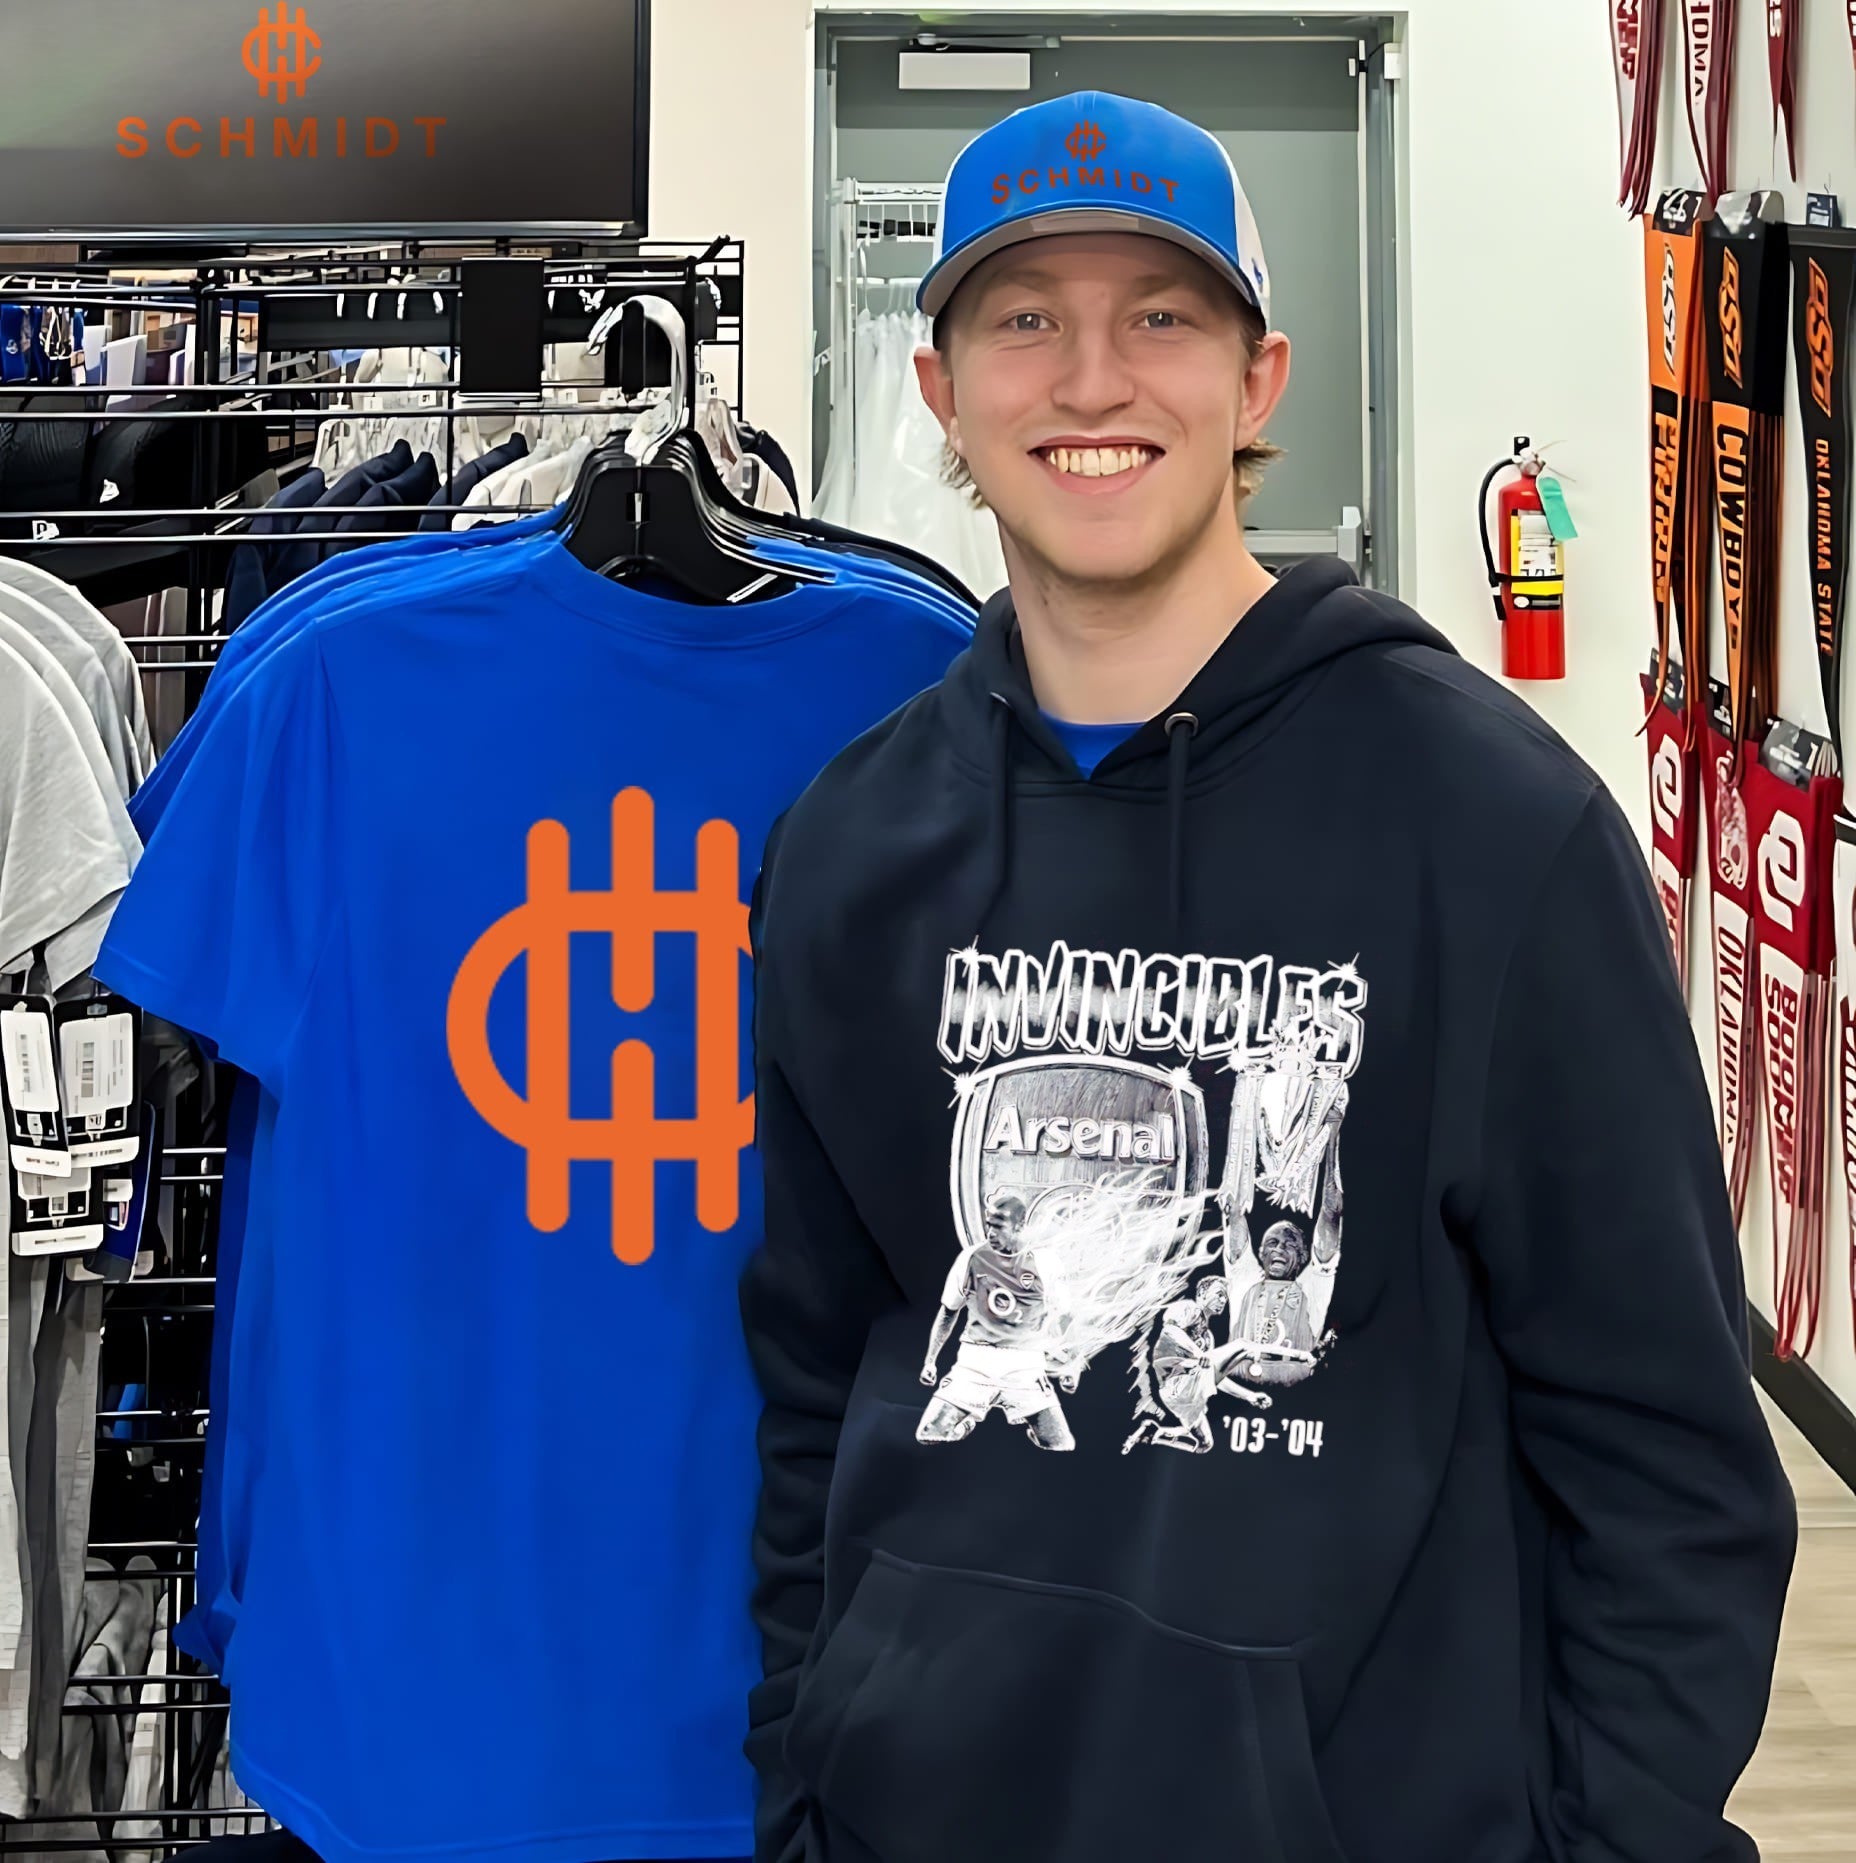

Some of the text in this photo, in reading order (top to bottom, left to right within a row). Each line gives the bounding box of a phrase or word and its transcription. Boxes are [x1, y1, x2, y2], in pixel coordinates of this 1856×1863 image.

[115, 116, 447, 159] SCHMIDT
[991, 167, 1179, 205] SCHMIDT
[1815, 439, 1832, 570] OKLAHOMA
[938, 940, 1368, 1078] INVINCIBLES
[1718, 926, 1745, 1144] OKLAHOMA
[984, 1104, 1175, 1162] Arsenal
